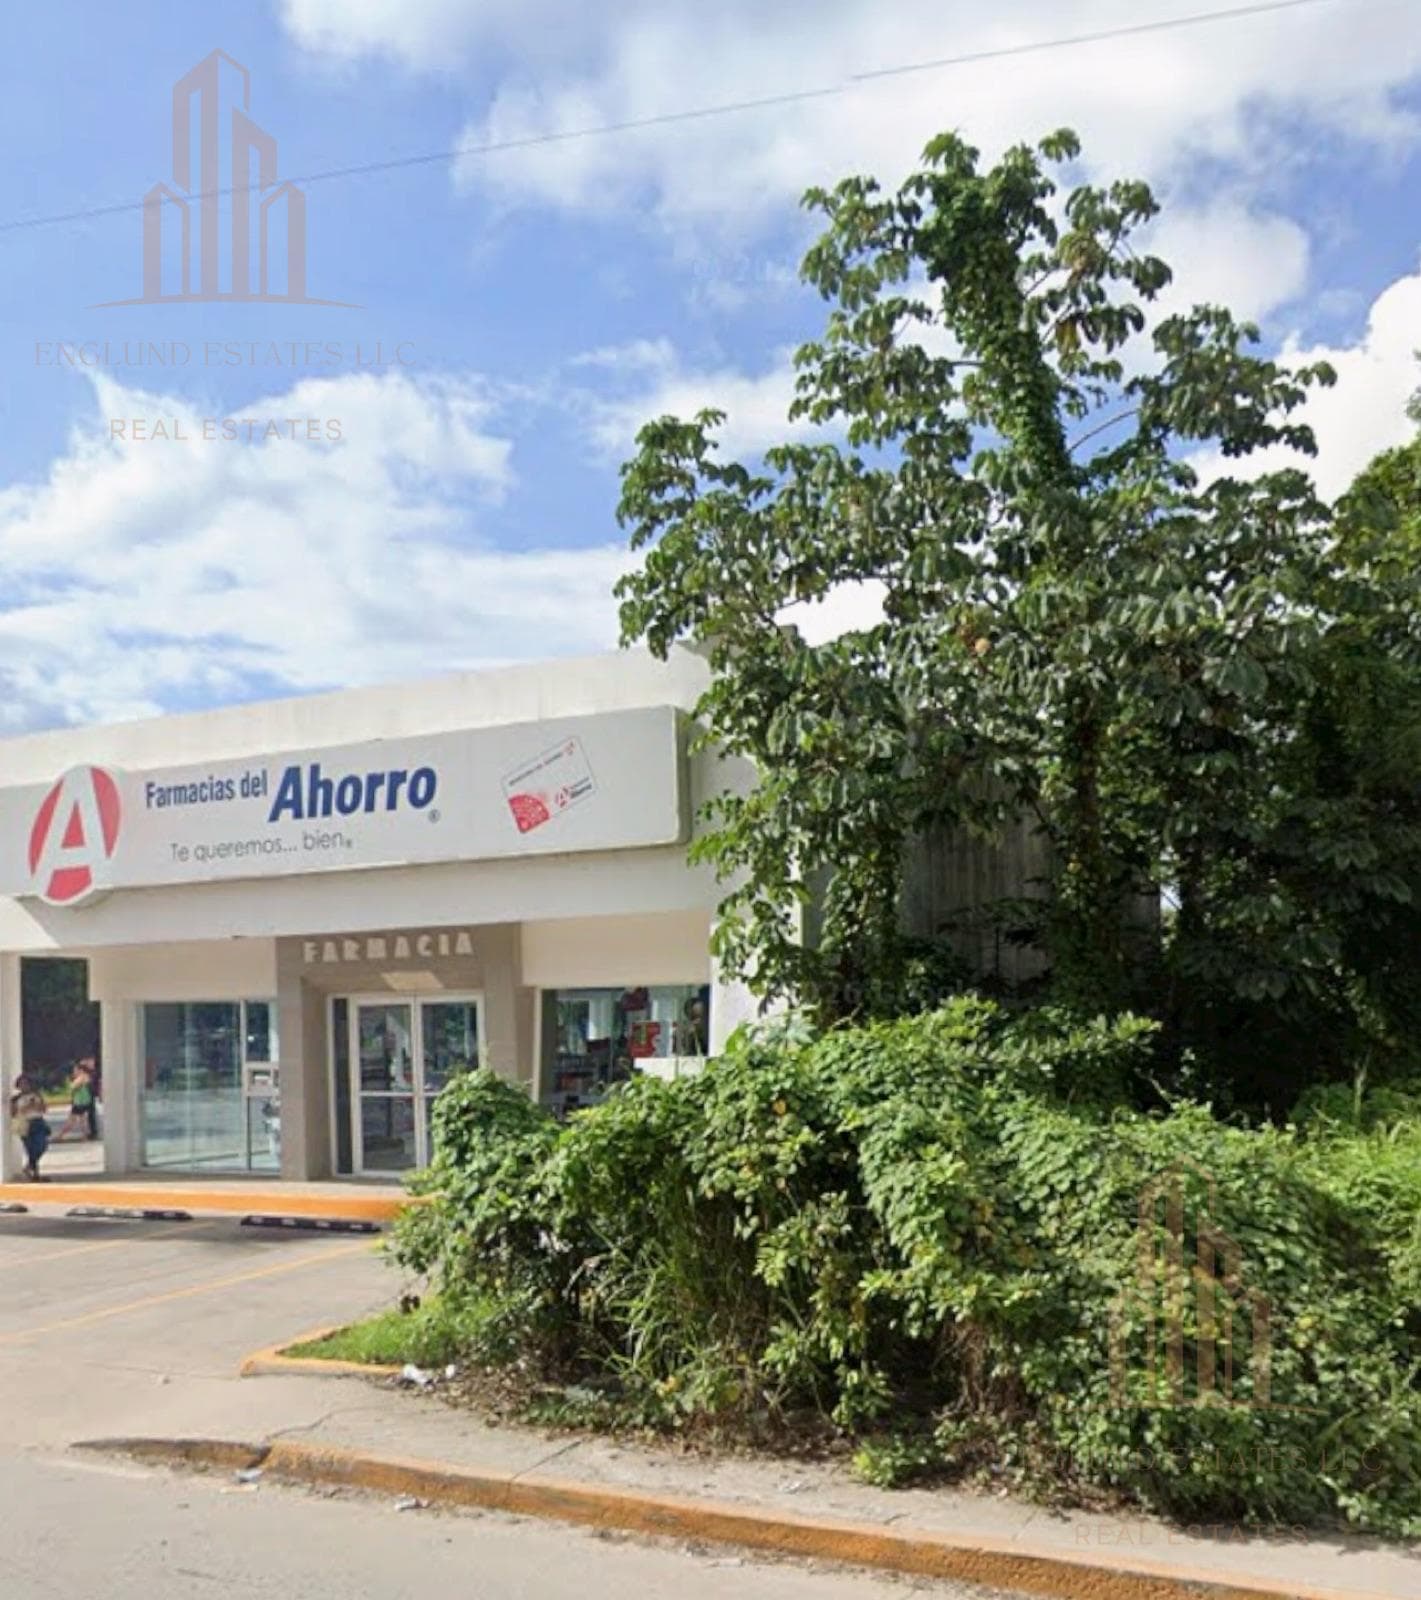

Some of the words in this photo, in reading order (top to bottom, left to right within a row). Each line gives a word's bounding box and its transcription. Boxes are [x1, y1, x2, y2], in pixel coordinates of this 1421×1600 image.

[145, 774, 234, 808] Farmacias
[241, 770, 267, 798] del
[268, 763, 436, 822] Ahorro
[171, 842, 189, 861] Te
[303, 932, 474, 963] FARMACIA
